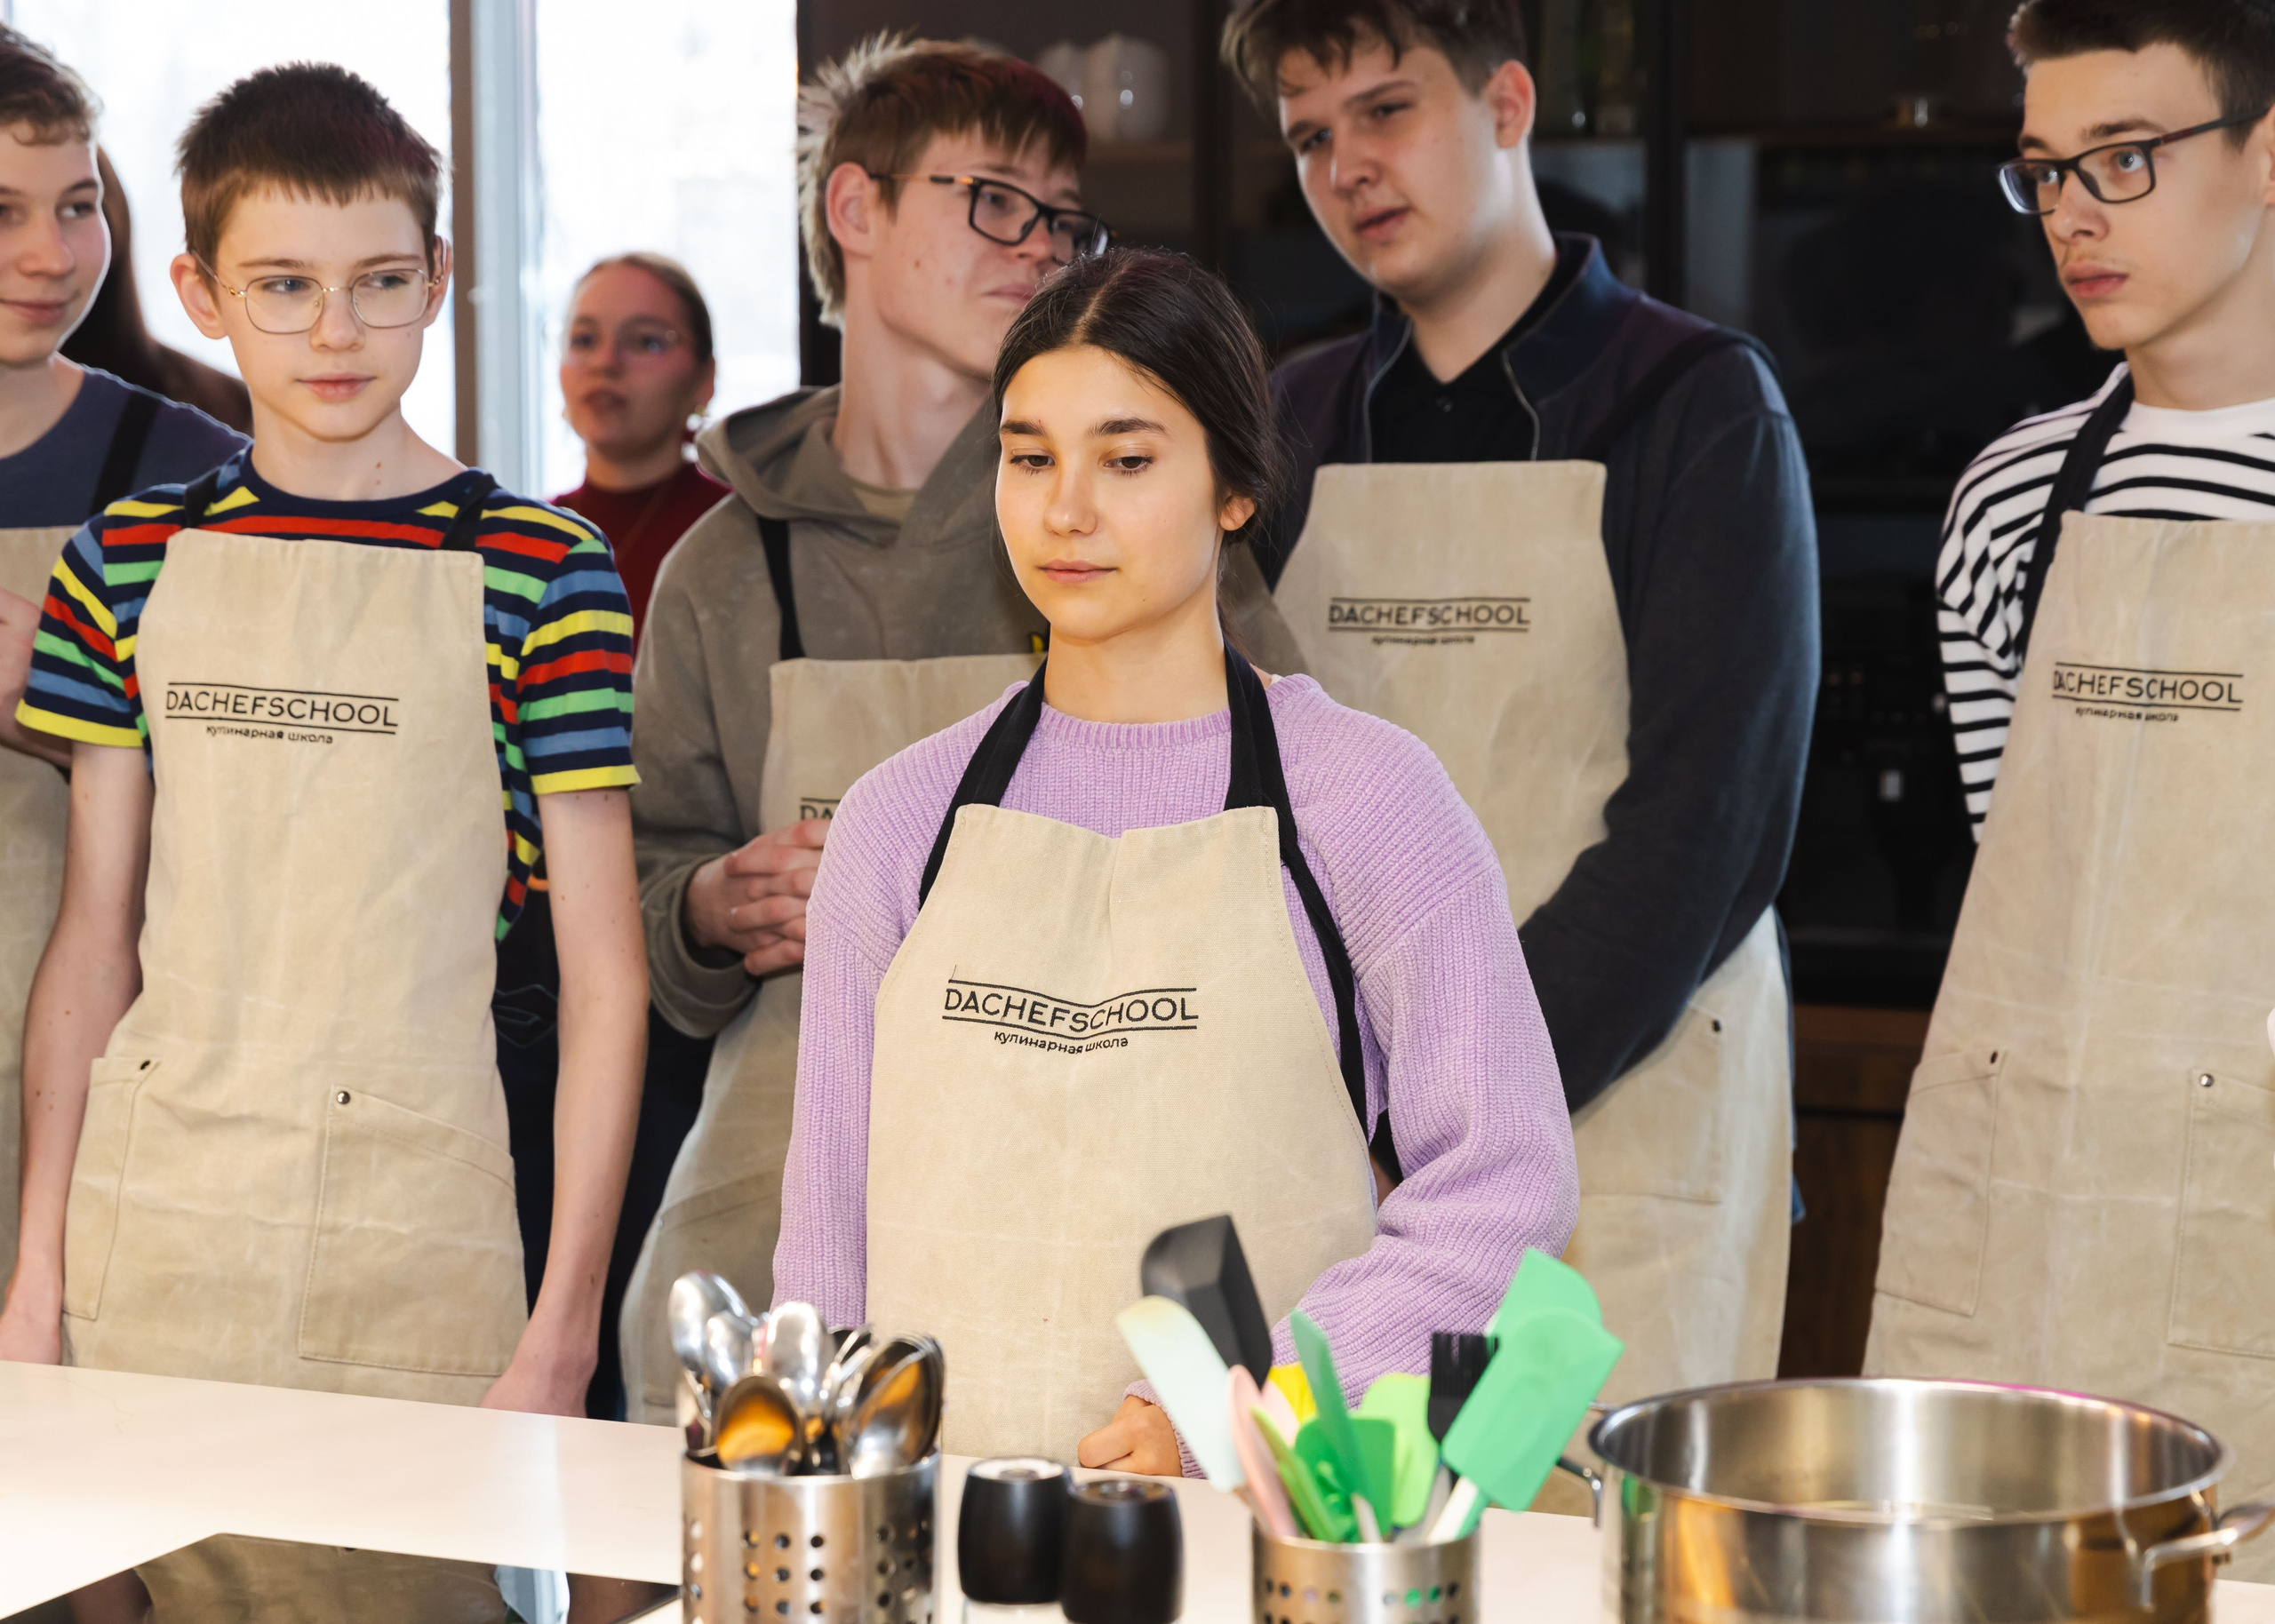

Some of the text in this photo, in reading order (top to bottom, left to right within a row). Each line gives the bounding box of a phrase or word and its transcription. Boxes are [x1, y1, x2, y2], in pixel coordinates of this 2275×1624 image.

[1329, 604, 1530, 625] DACHEFSCHOOL
[2053, 670, 2244, 704] DACHEFSCHOOL
[166, 690, 399, 728] DACHEFSCHOOL
[206, 726, 333, 744] кулинарная школа
[944, 988, 1199, 1033] DACHEFSCHOOL
[994, 1031, 1129, 1055] кулинарная школа
